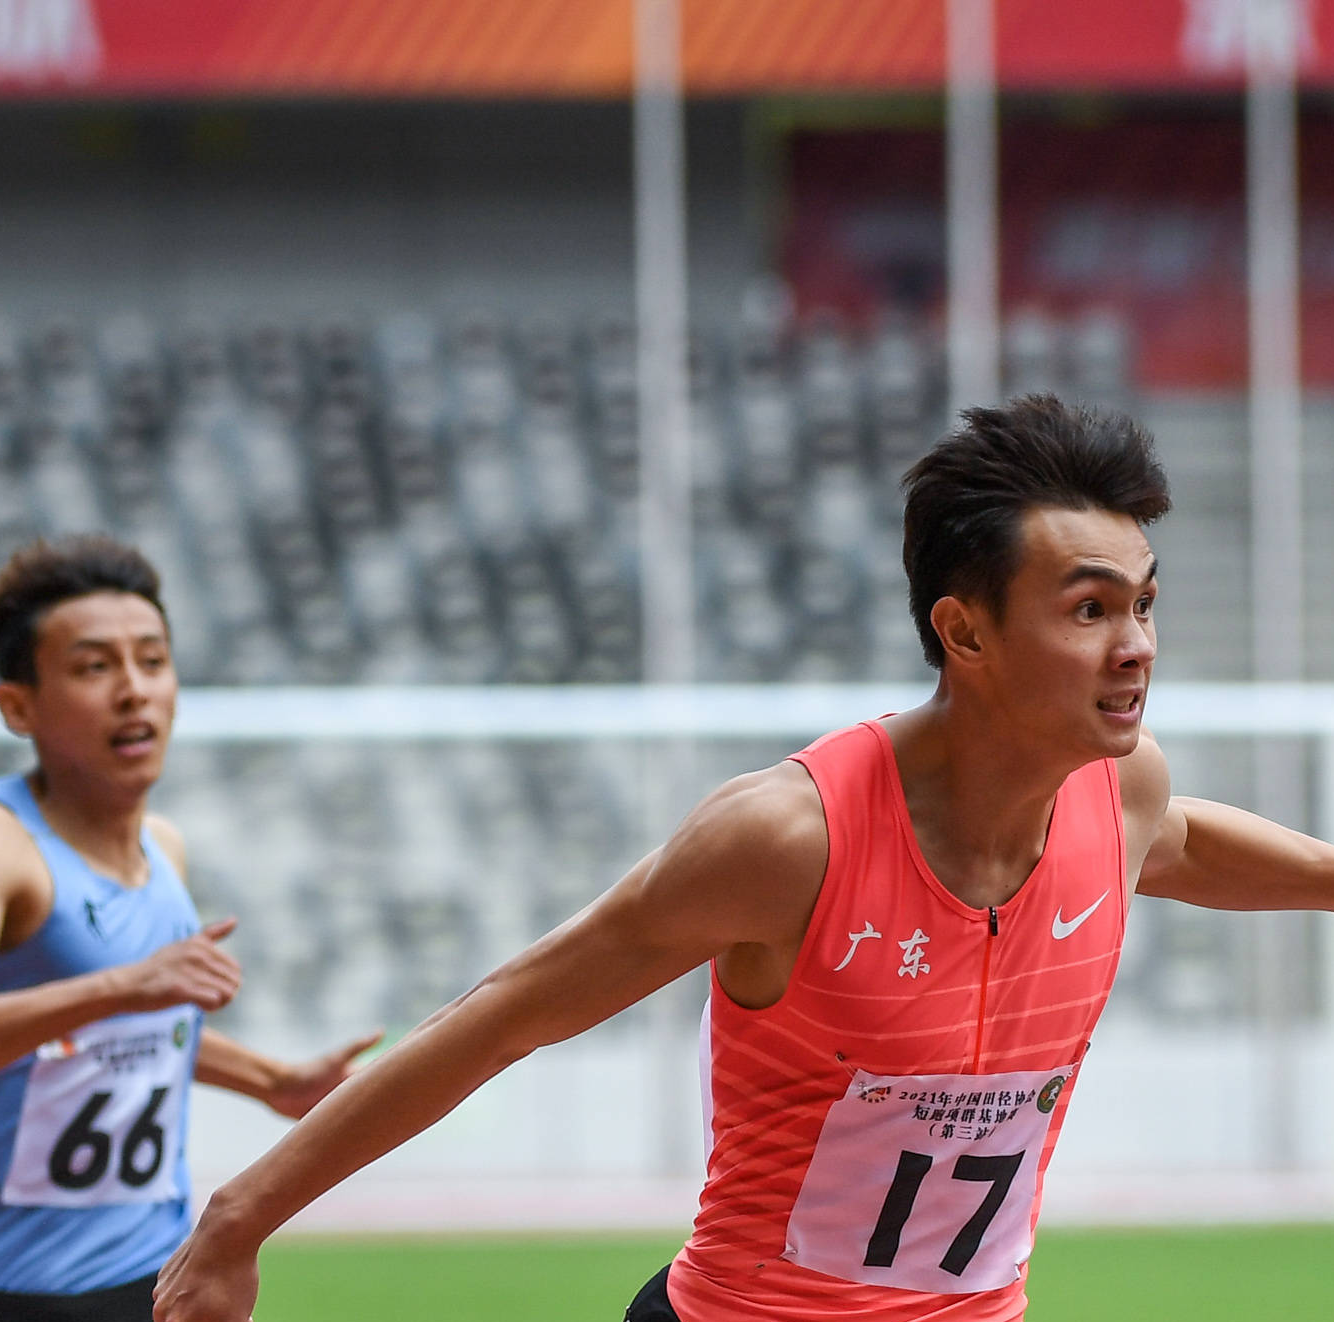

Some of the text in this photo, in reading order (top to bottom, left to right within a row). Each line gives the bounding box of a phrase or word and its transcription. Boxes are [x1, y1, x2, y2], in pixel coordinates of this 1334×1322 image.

[833, 920, 930, 979] 广东
[48, 1086, 169, 1191] 66
[863, 1149, 1026, 1276] 17
